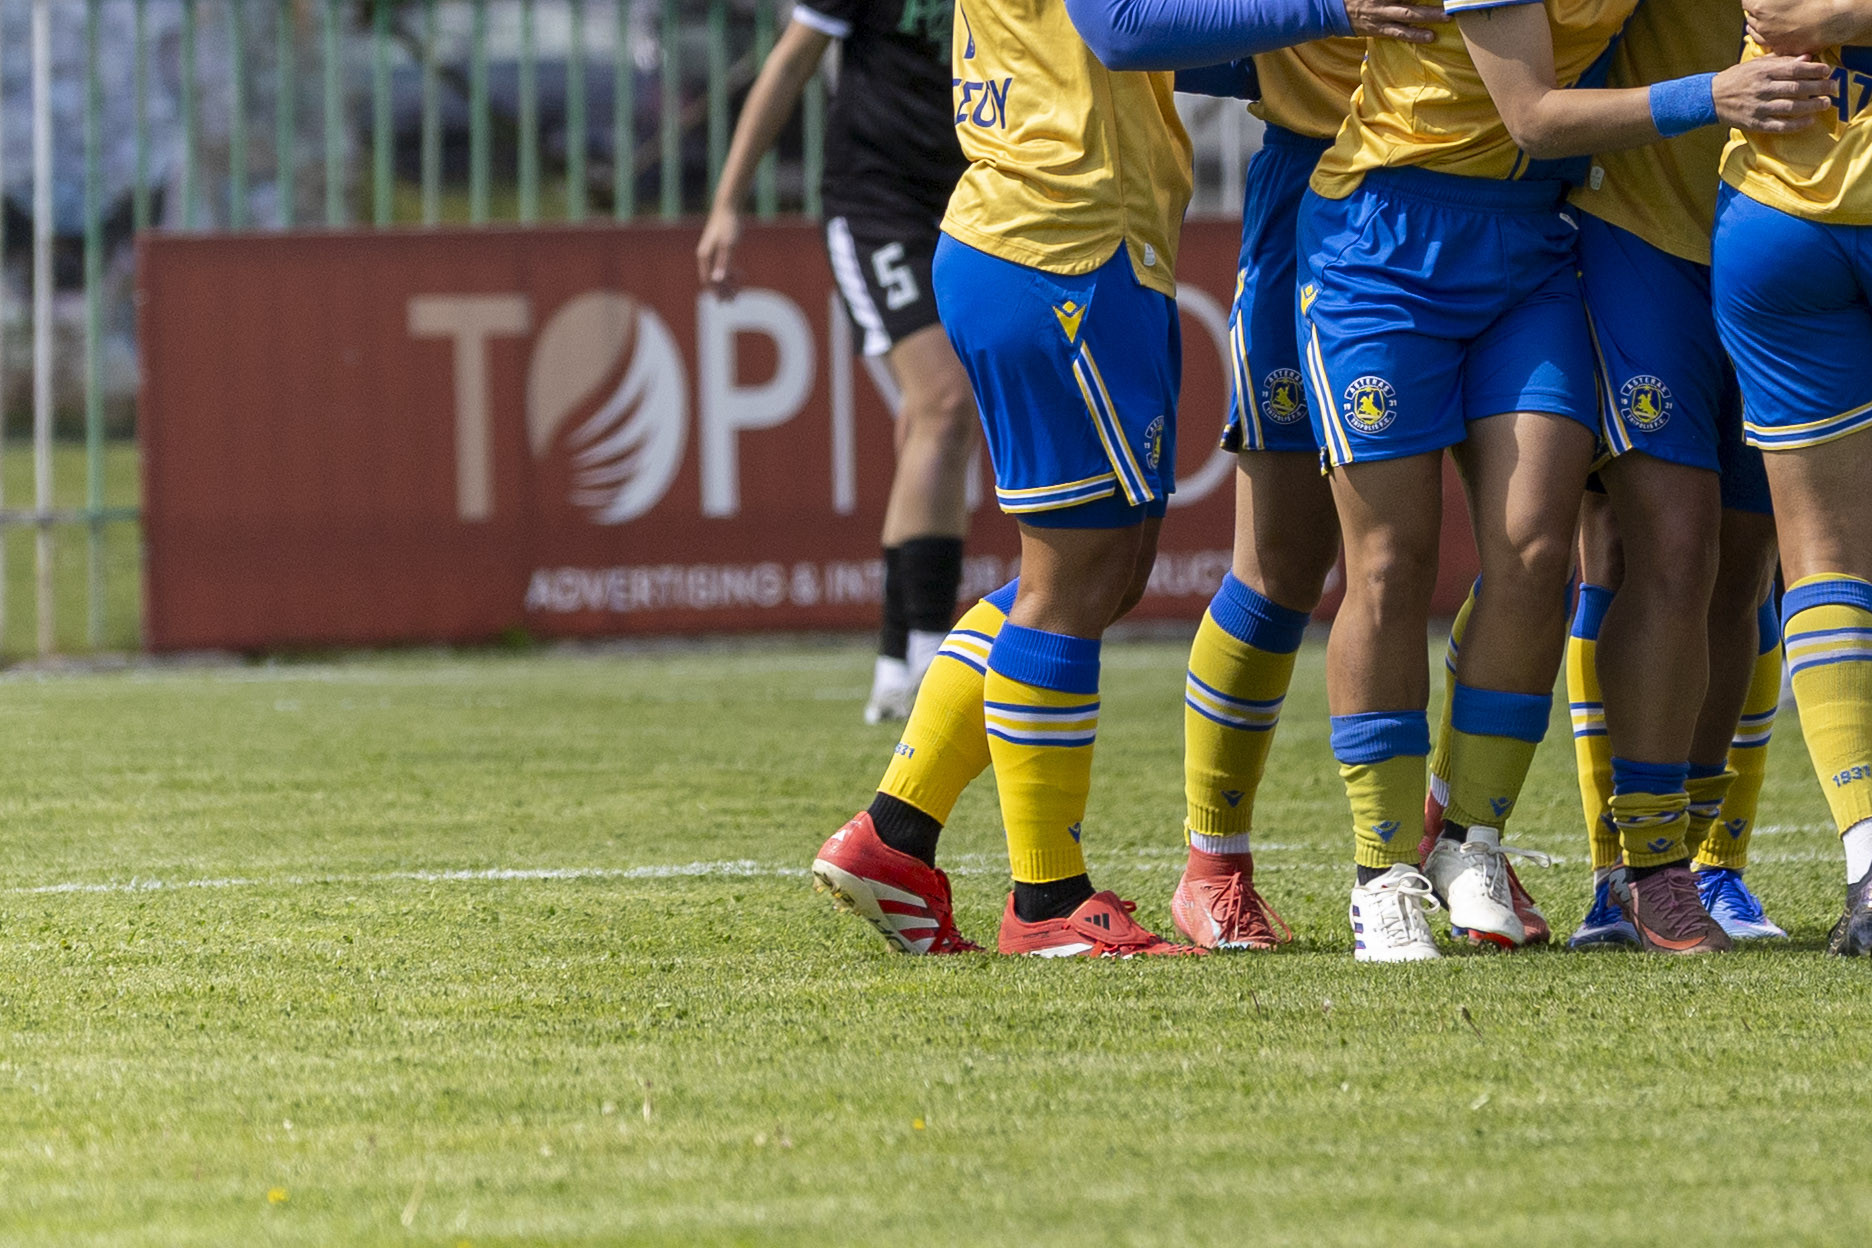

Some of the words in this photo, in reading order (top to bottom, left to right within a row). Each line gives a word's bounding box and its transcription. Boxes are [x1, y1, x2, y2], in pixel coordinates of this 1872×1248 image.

[870, 241, 920, 311] 5
[1626, 376, 1668, 393] ASTERAS
[1831, 764, 1871, 788] 1931
